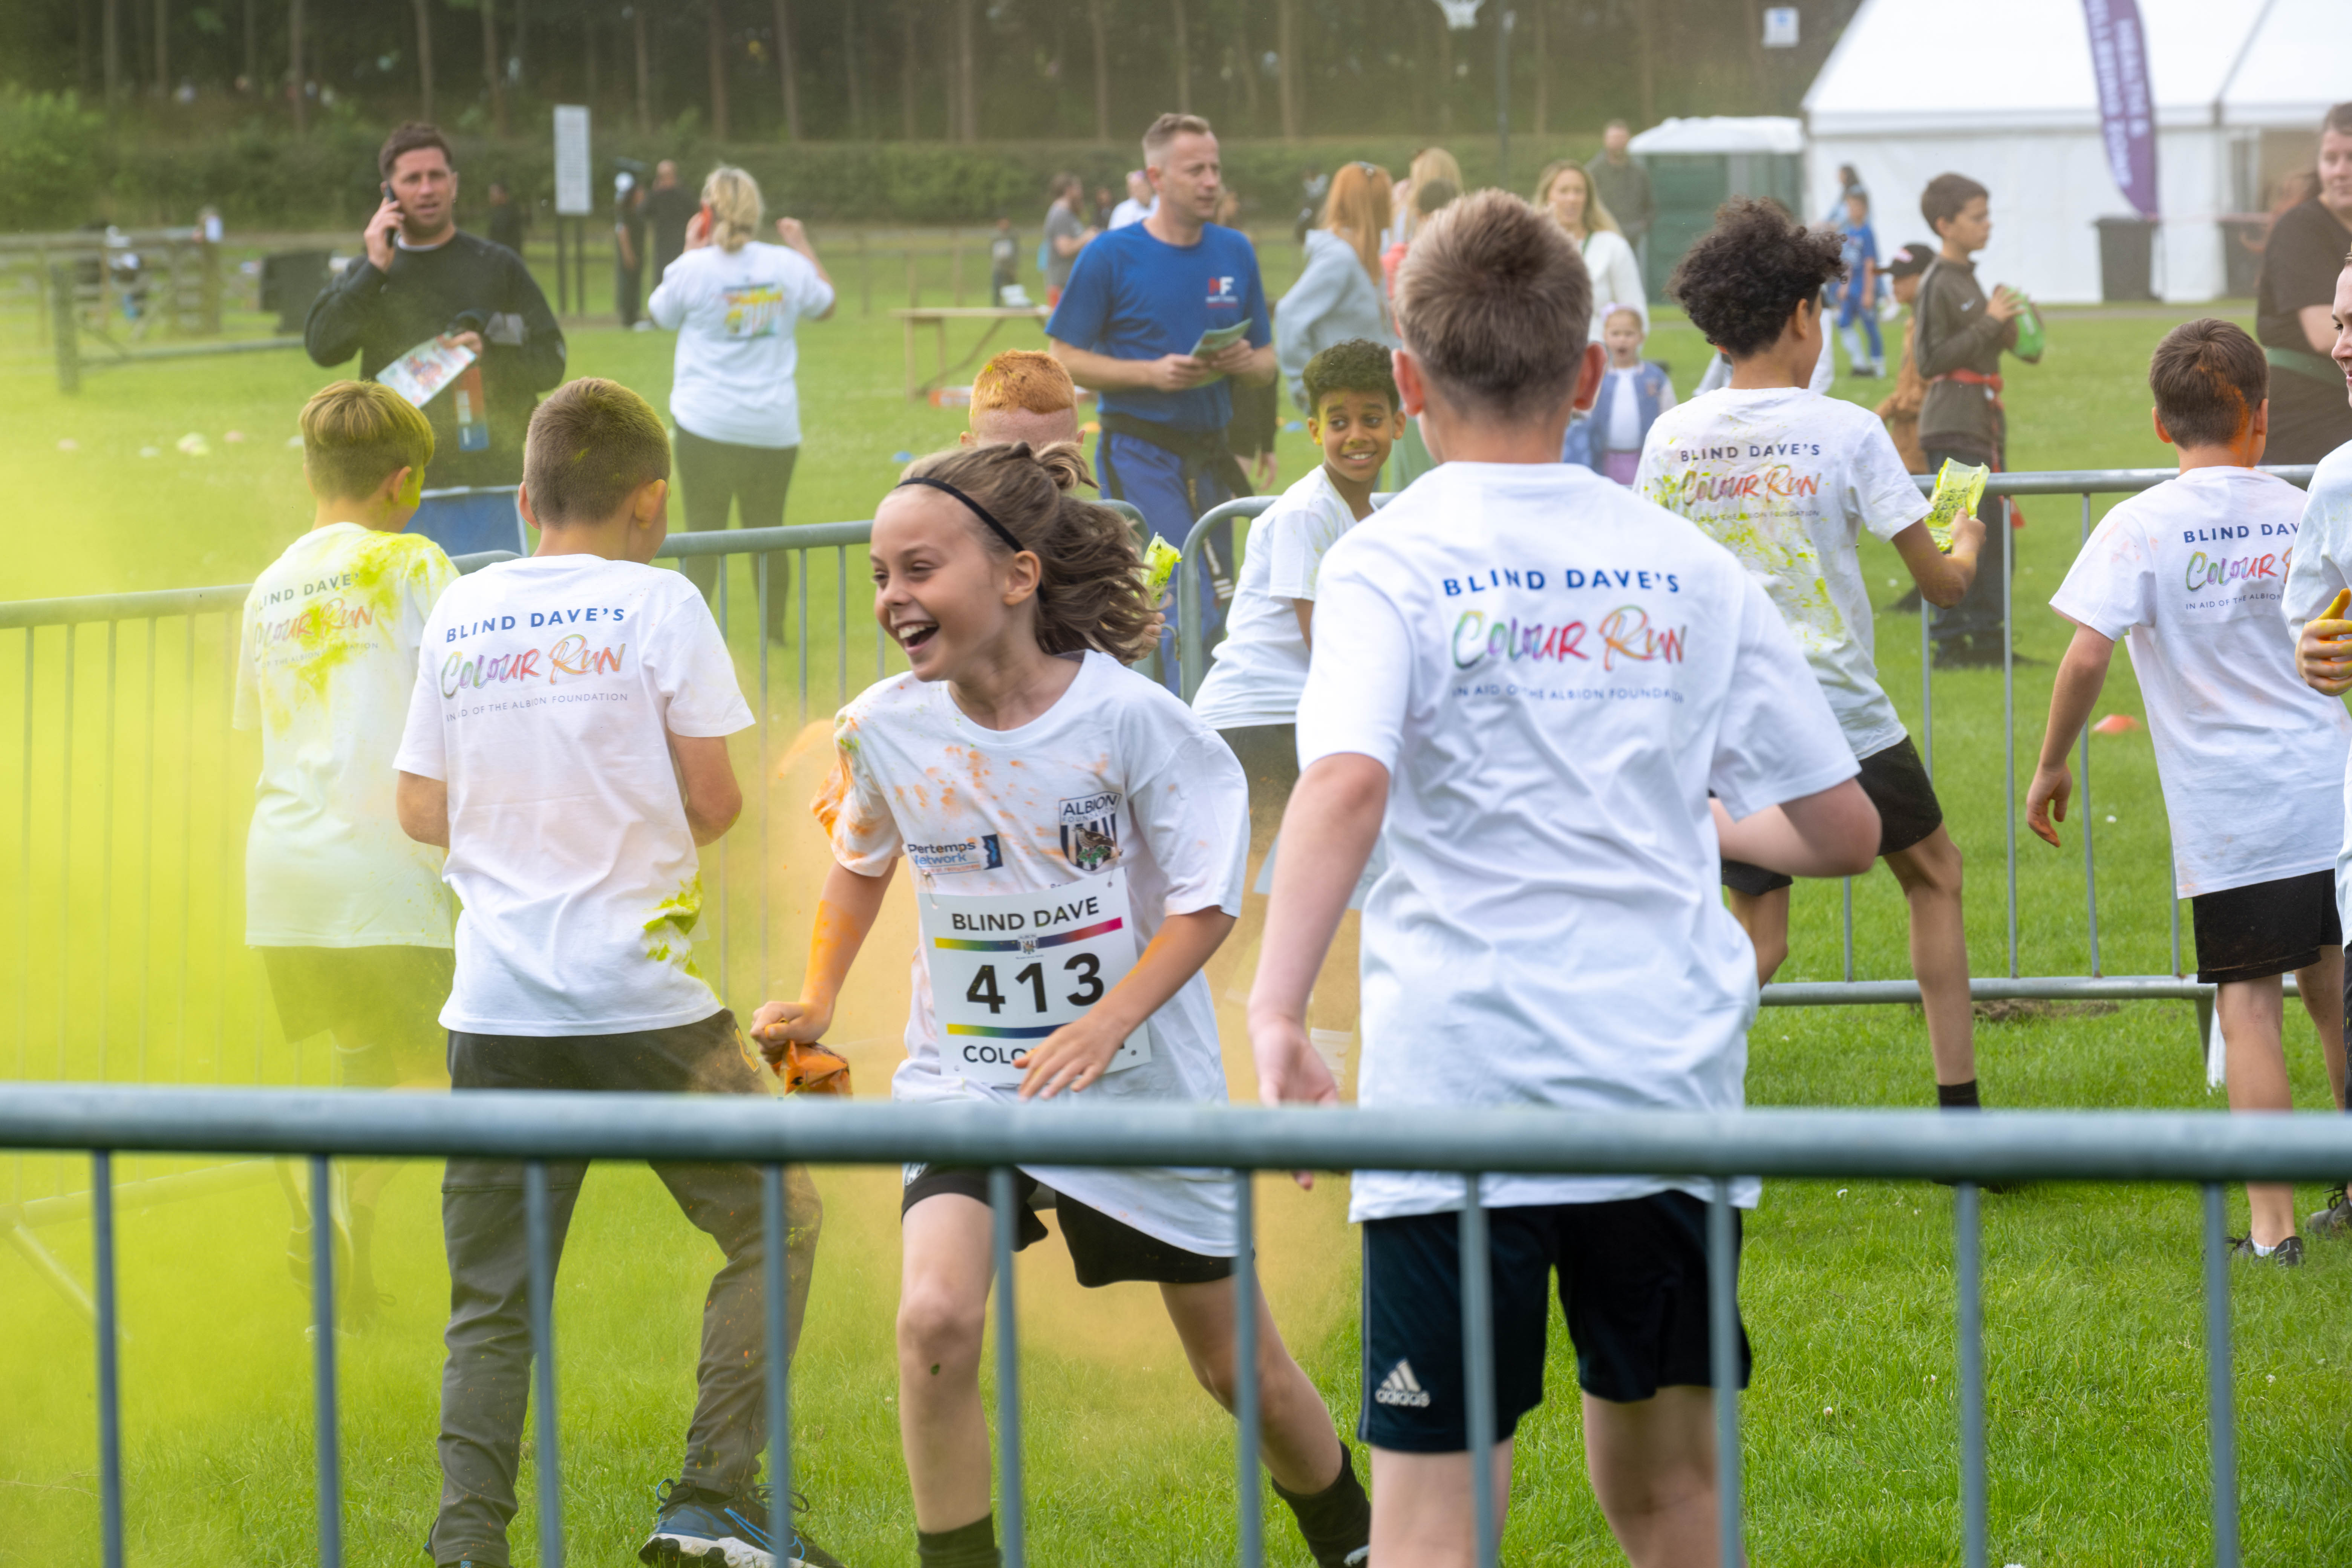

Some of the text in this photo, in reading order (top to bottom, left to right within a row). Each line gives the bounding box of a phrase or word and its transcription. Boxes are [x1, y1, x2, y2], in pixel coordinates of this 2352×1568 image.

[1680, 444, 1820, 462] BLIND DAVE'S
[2184, 523, 2300, 543] BLIND DAV
[256, 573, 359, 611] LIND DAVE'
[1443, 568, 1679, 596] BLIND DAVE'S
[2234, 595, 2246, 603] THE
[446, 608, 624, 643] BLIND DAVE'S
[292, 651, 319, 662] ALBION
[1474, 684, 1500, 695] AID
[1506, 684, 1518, 696] O
[1550, 688, 1604, 700] ALBION
[446, 713, 456, 722] IN
[473, 706, 484, 714] OF
[488, 703, 507, 712] THE
[512, 697, 546, 708] ALBION
[552, 694, 628, 703] FOUNDATION
[1063, 795, 1117, 816] ALBION
[908, 842, 976, 853] Pertemps
[952, 896, 1099, 931] BLIND DAVE
[966, 952, 1104, 1014] 413
[963, 1045, 1030, 1064] COLO
[1375, 1388, 1430, 1407] adidas
